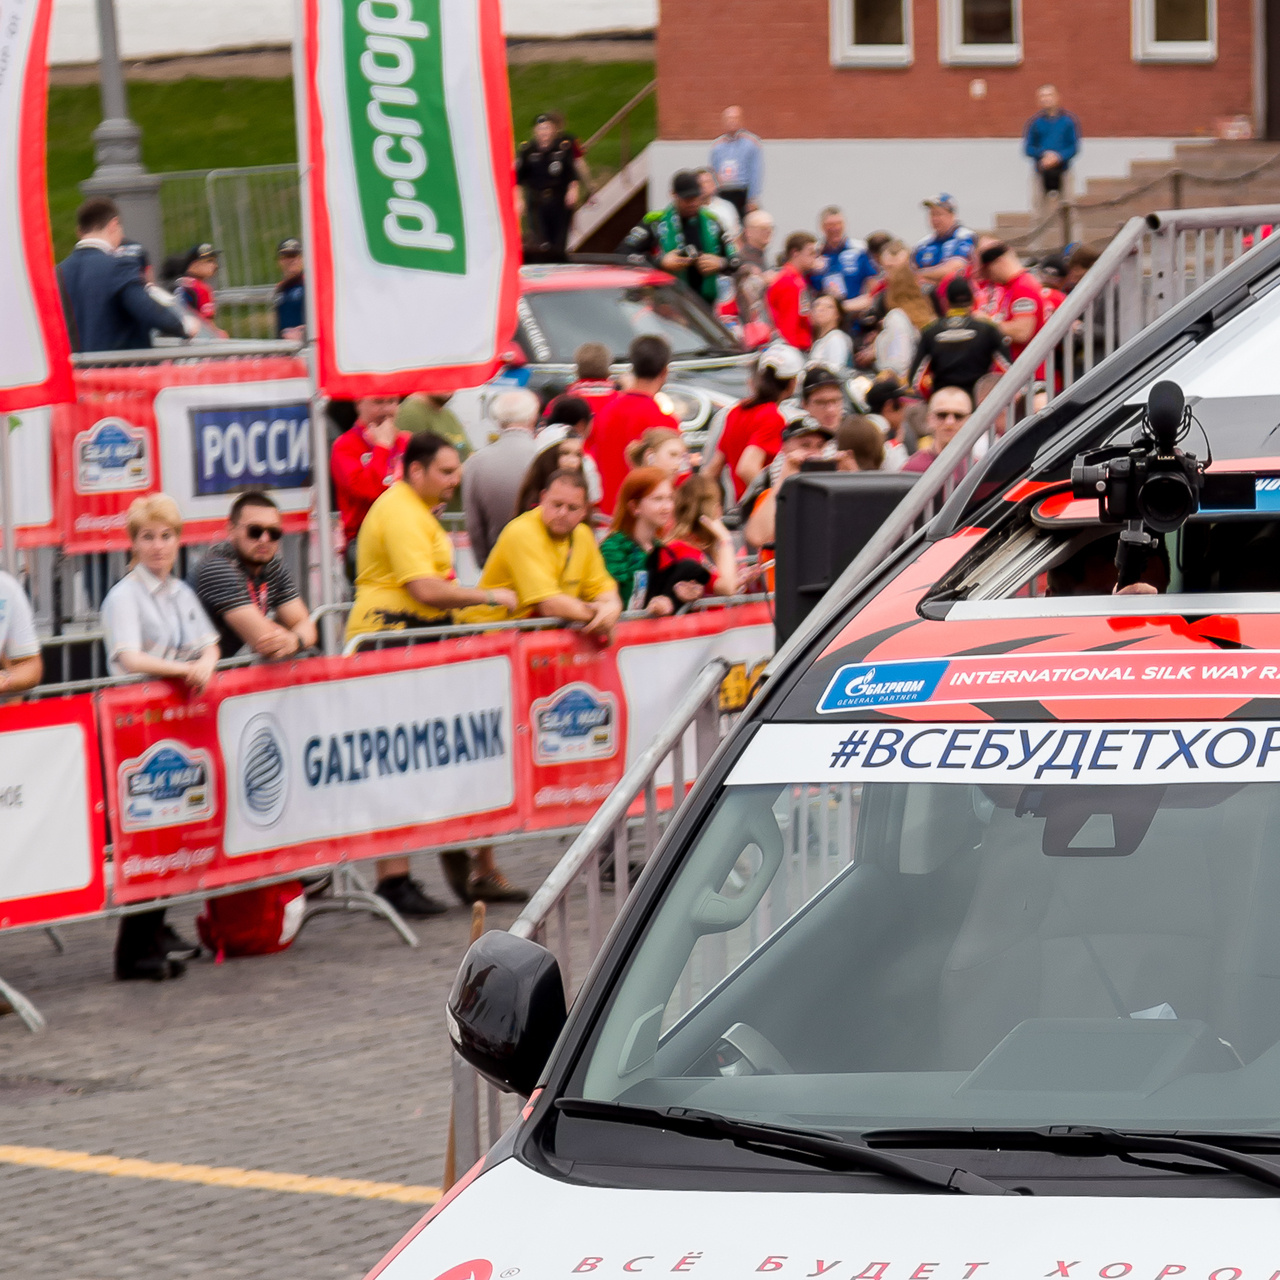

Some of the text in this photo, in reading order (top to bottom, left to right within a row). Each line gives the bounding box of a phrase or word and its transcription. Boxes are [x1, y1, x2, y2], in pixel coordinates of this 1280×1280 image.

[950, 666, 1136, 686] INTERNATIONAL
[1141, 666, 1195, 681] SILK
[1201, 665, 1256, 680] WAY
[867, 679, 925, 696] GAZPROM
[837, 693, 918, 706] GENERAL PARTNER
[304, 706, 504, 789] GAZPROMBANK
[572, 1251, 706, 1275] ВСЁ
